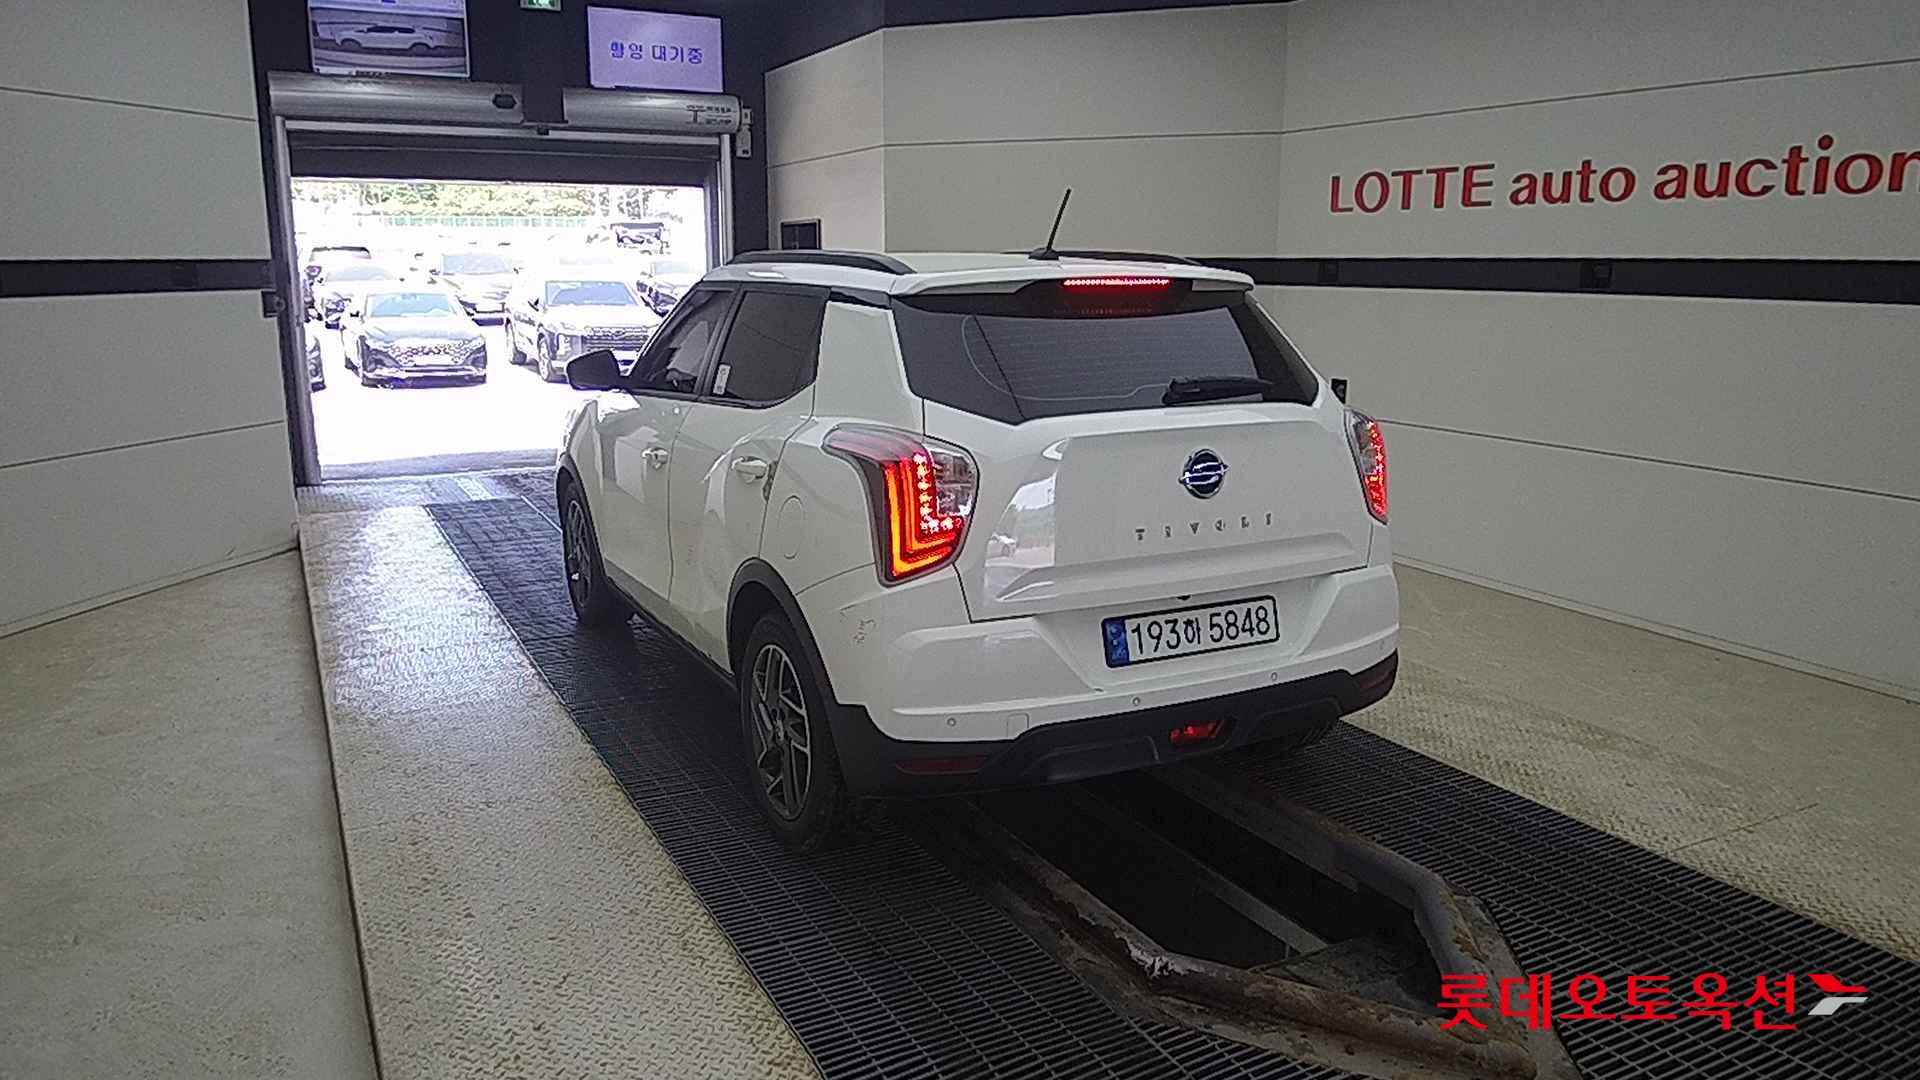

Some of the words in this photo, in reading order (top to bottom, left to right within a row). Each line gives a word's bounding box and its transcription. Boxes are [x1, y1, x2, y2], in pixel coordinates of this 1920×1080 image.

[652, 44, 703, 65] 대기중
[1330, 163, 1495, 213] LOTTE
[1509, 158, 1636, 205] auto
[1135, 512, 1272, 541] TIVOLI
[1131, 616, 1201, 655] 193하
[1209, 605, 1271, 643] 5848
